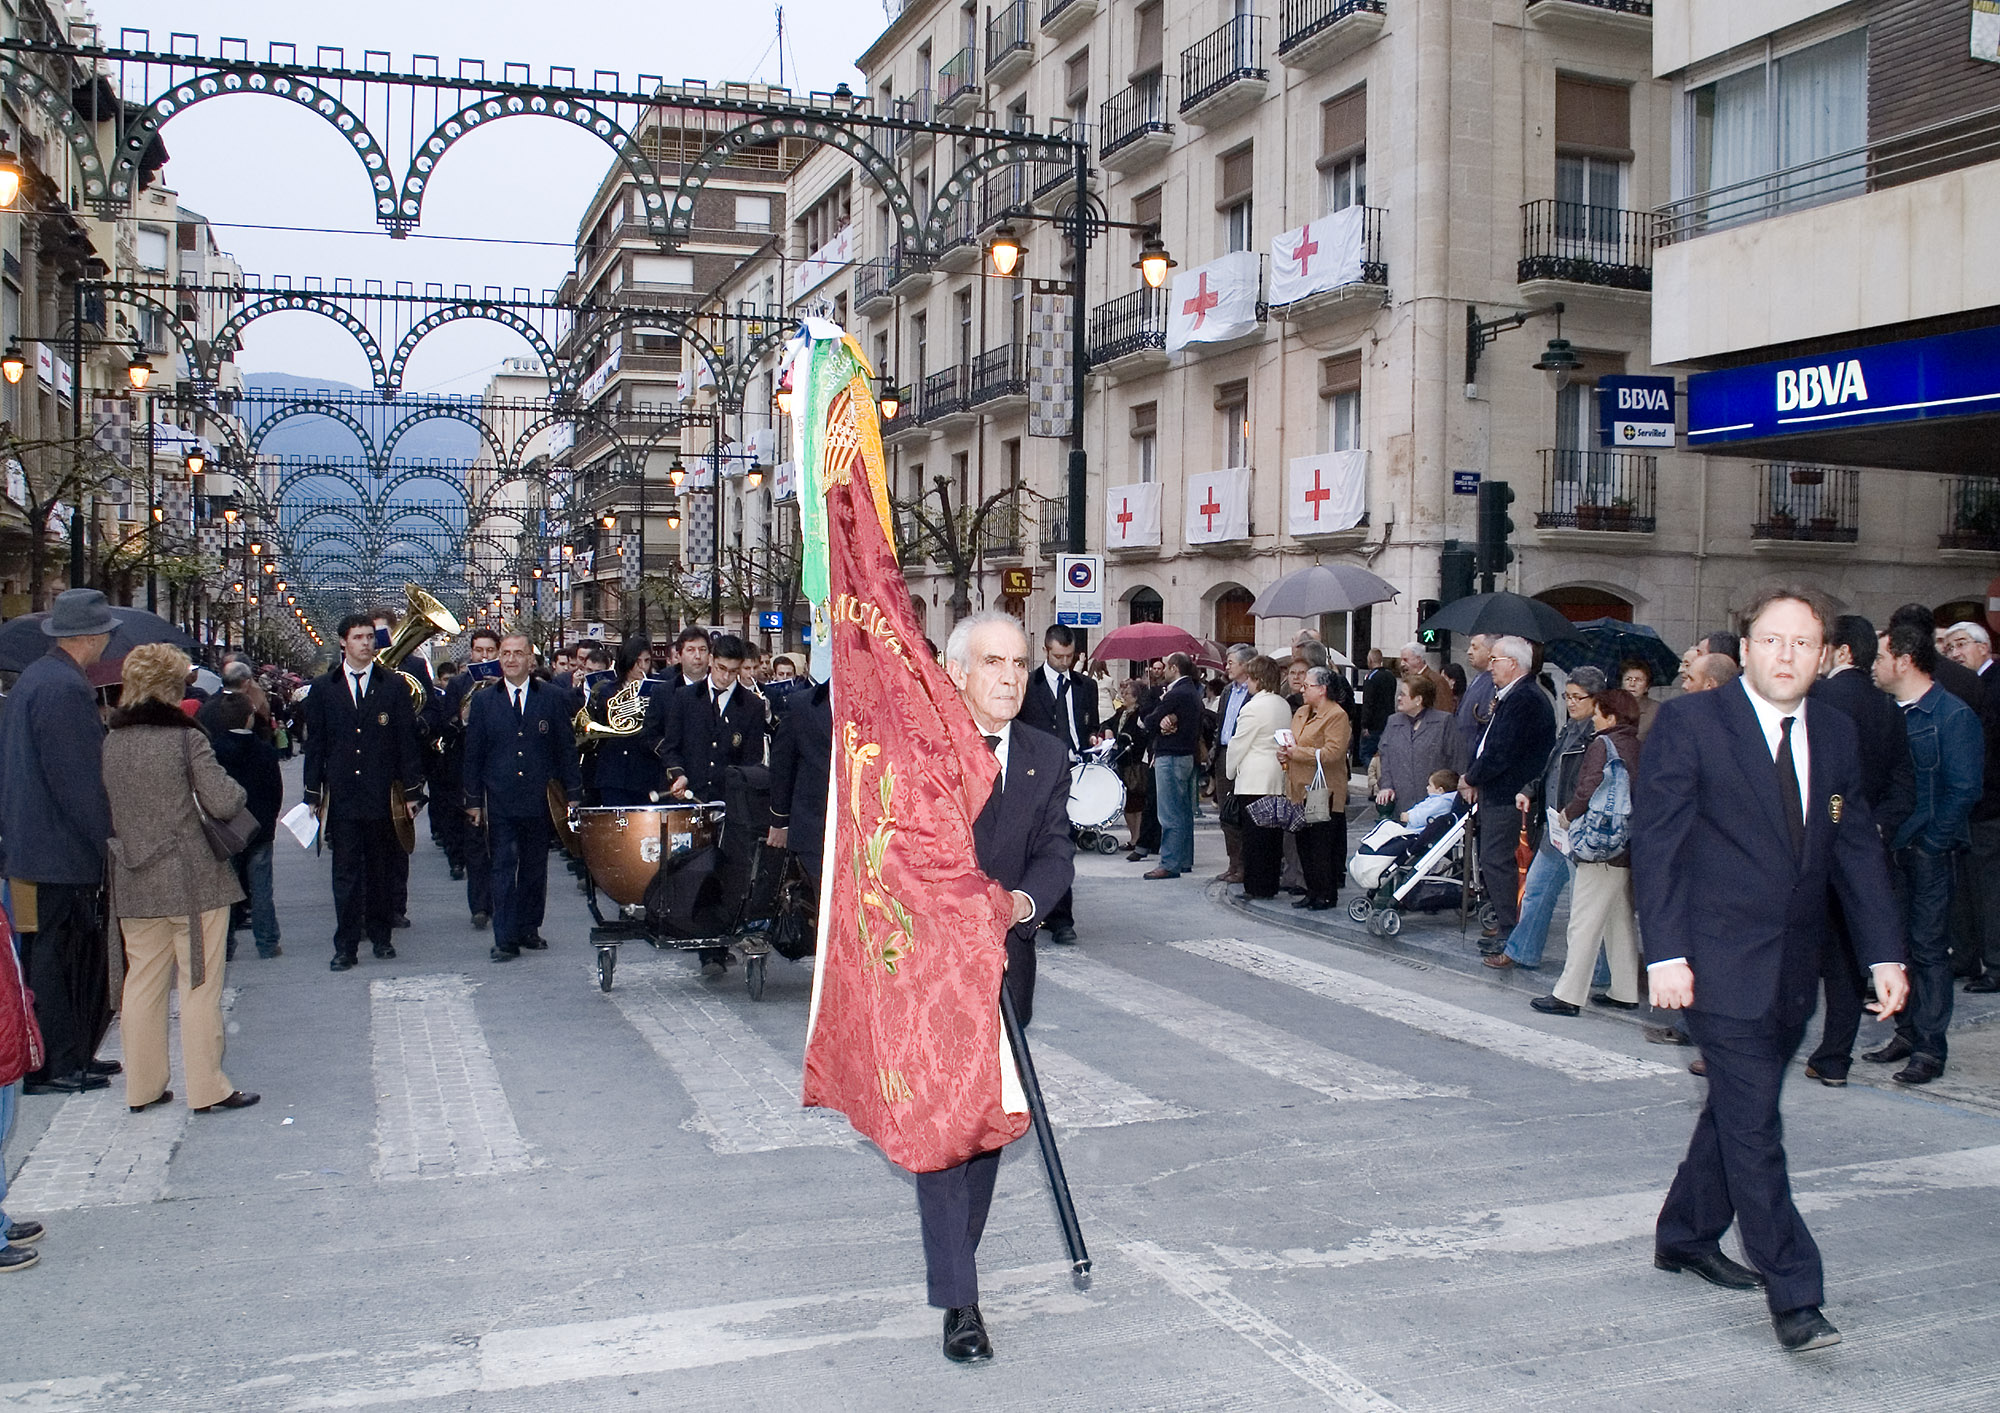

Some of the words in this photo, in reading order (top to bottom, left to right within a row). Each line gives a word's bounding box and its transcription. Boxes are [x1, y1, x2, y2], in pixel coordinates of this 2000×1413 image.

[1777, 359, 1868, 412] BBVA
[1618, 387, 1669, 411] BBVA
[1637, 428, 1667, 438] ServiRed
